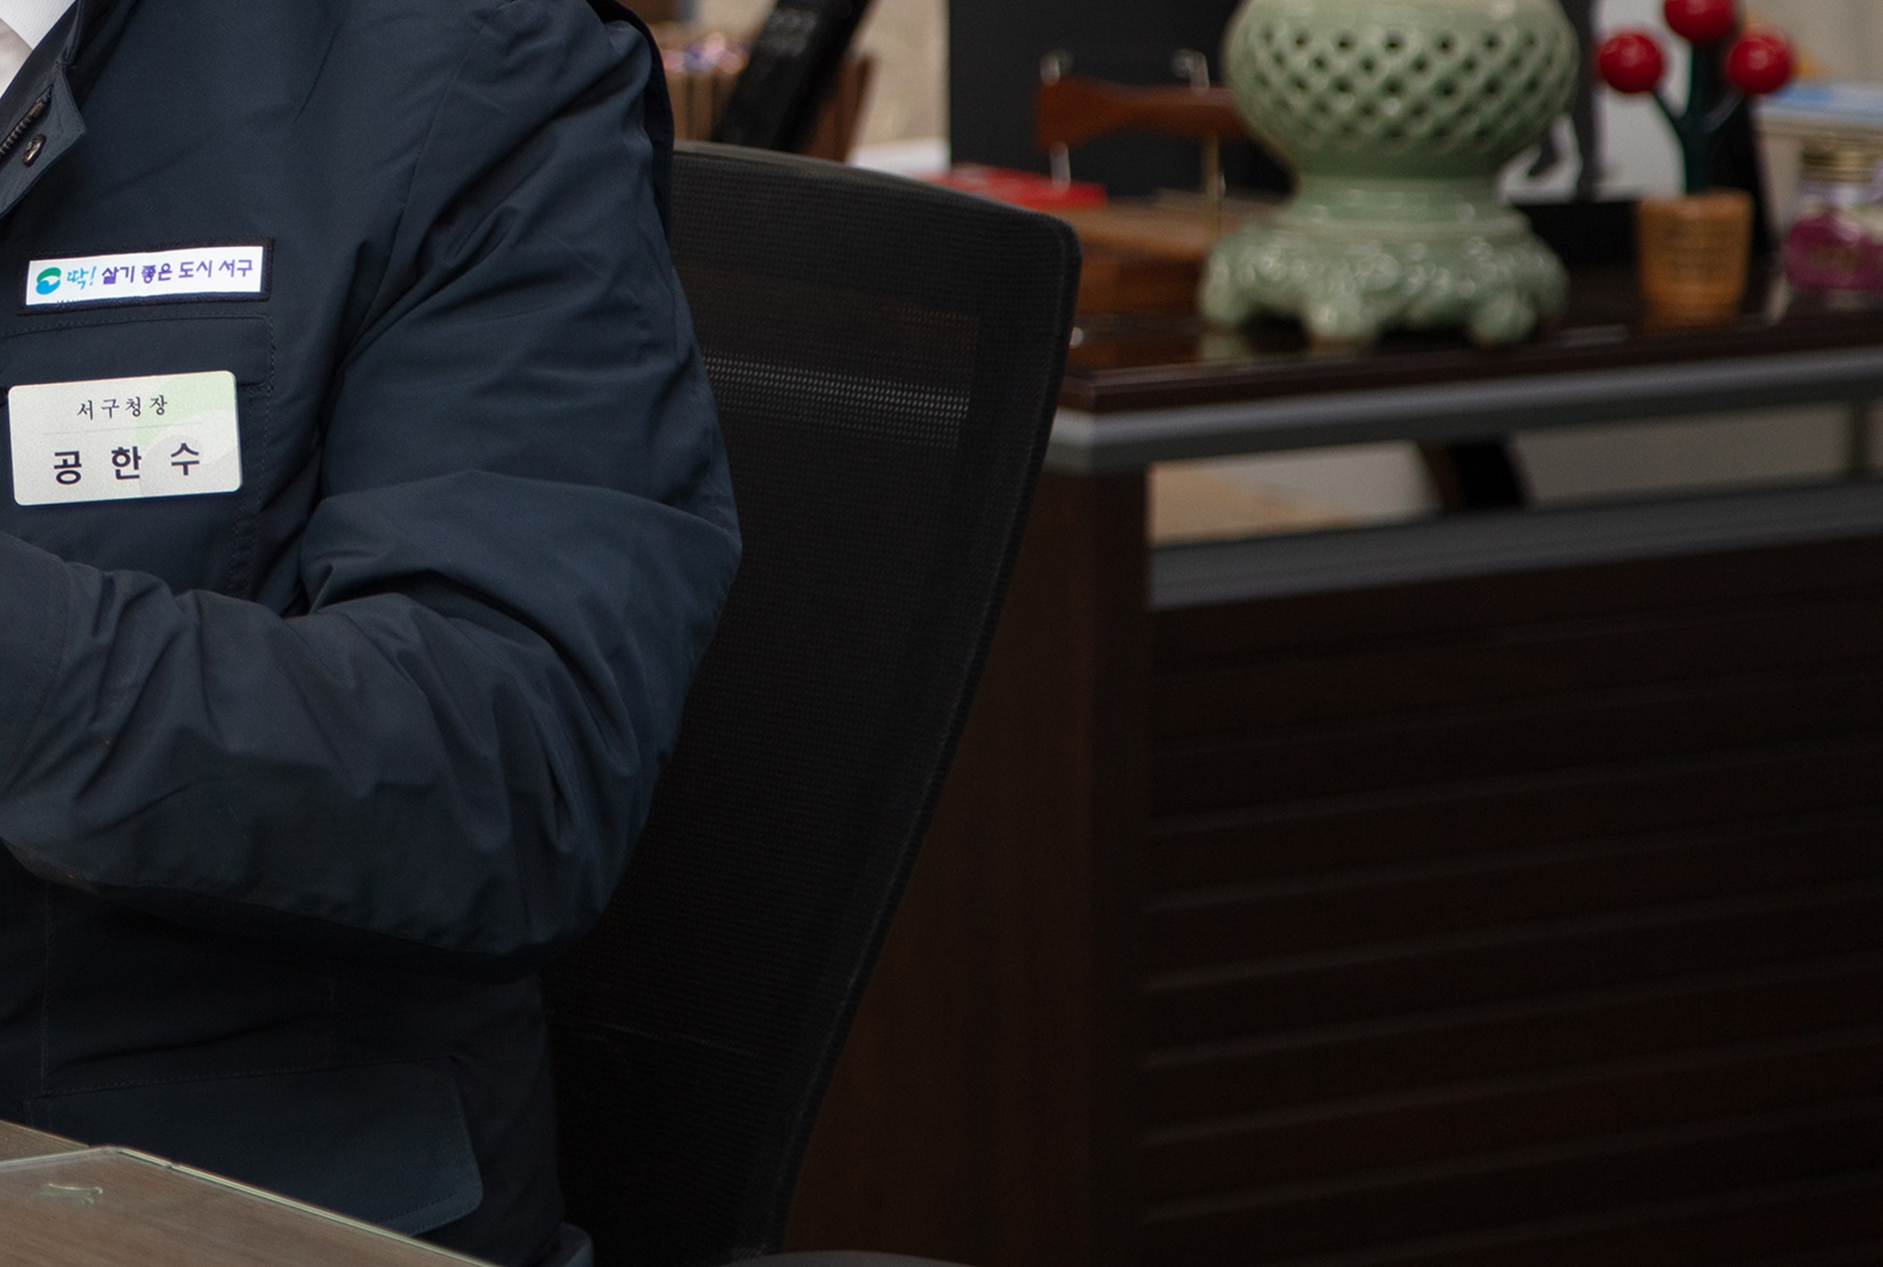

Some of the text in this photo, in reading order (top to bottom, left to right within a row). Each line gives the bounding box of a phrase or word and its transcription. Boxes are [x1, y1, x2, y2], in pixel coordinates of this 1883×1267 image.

[101, 265, 135, 285] 살기
[141, 262, 173, 284] 좋은
[178, 260, 213, 278] 도시
[219, 259, 253, 278] 서구
[76, 394, 169, 421] 서구청장
